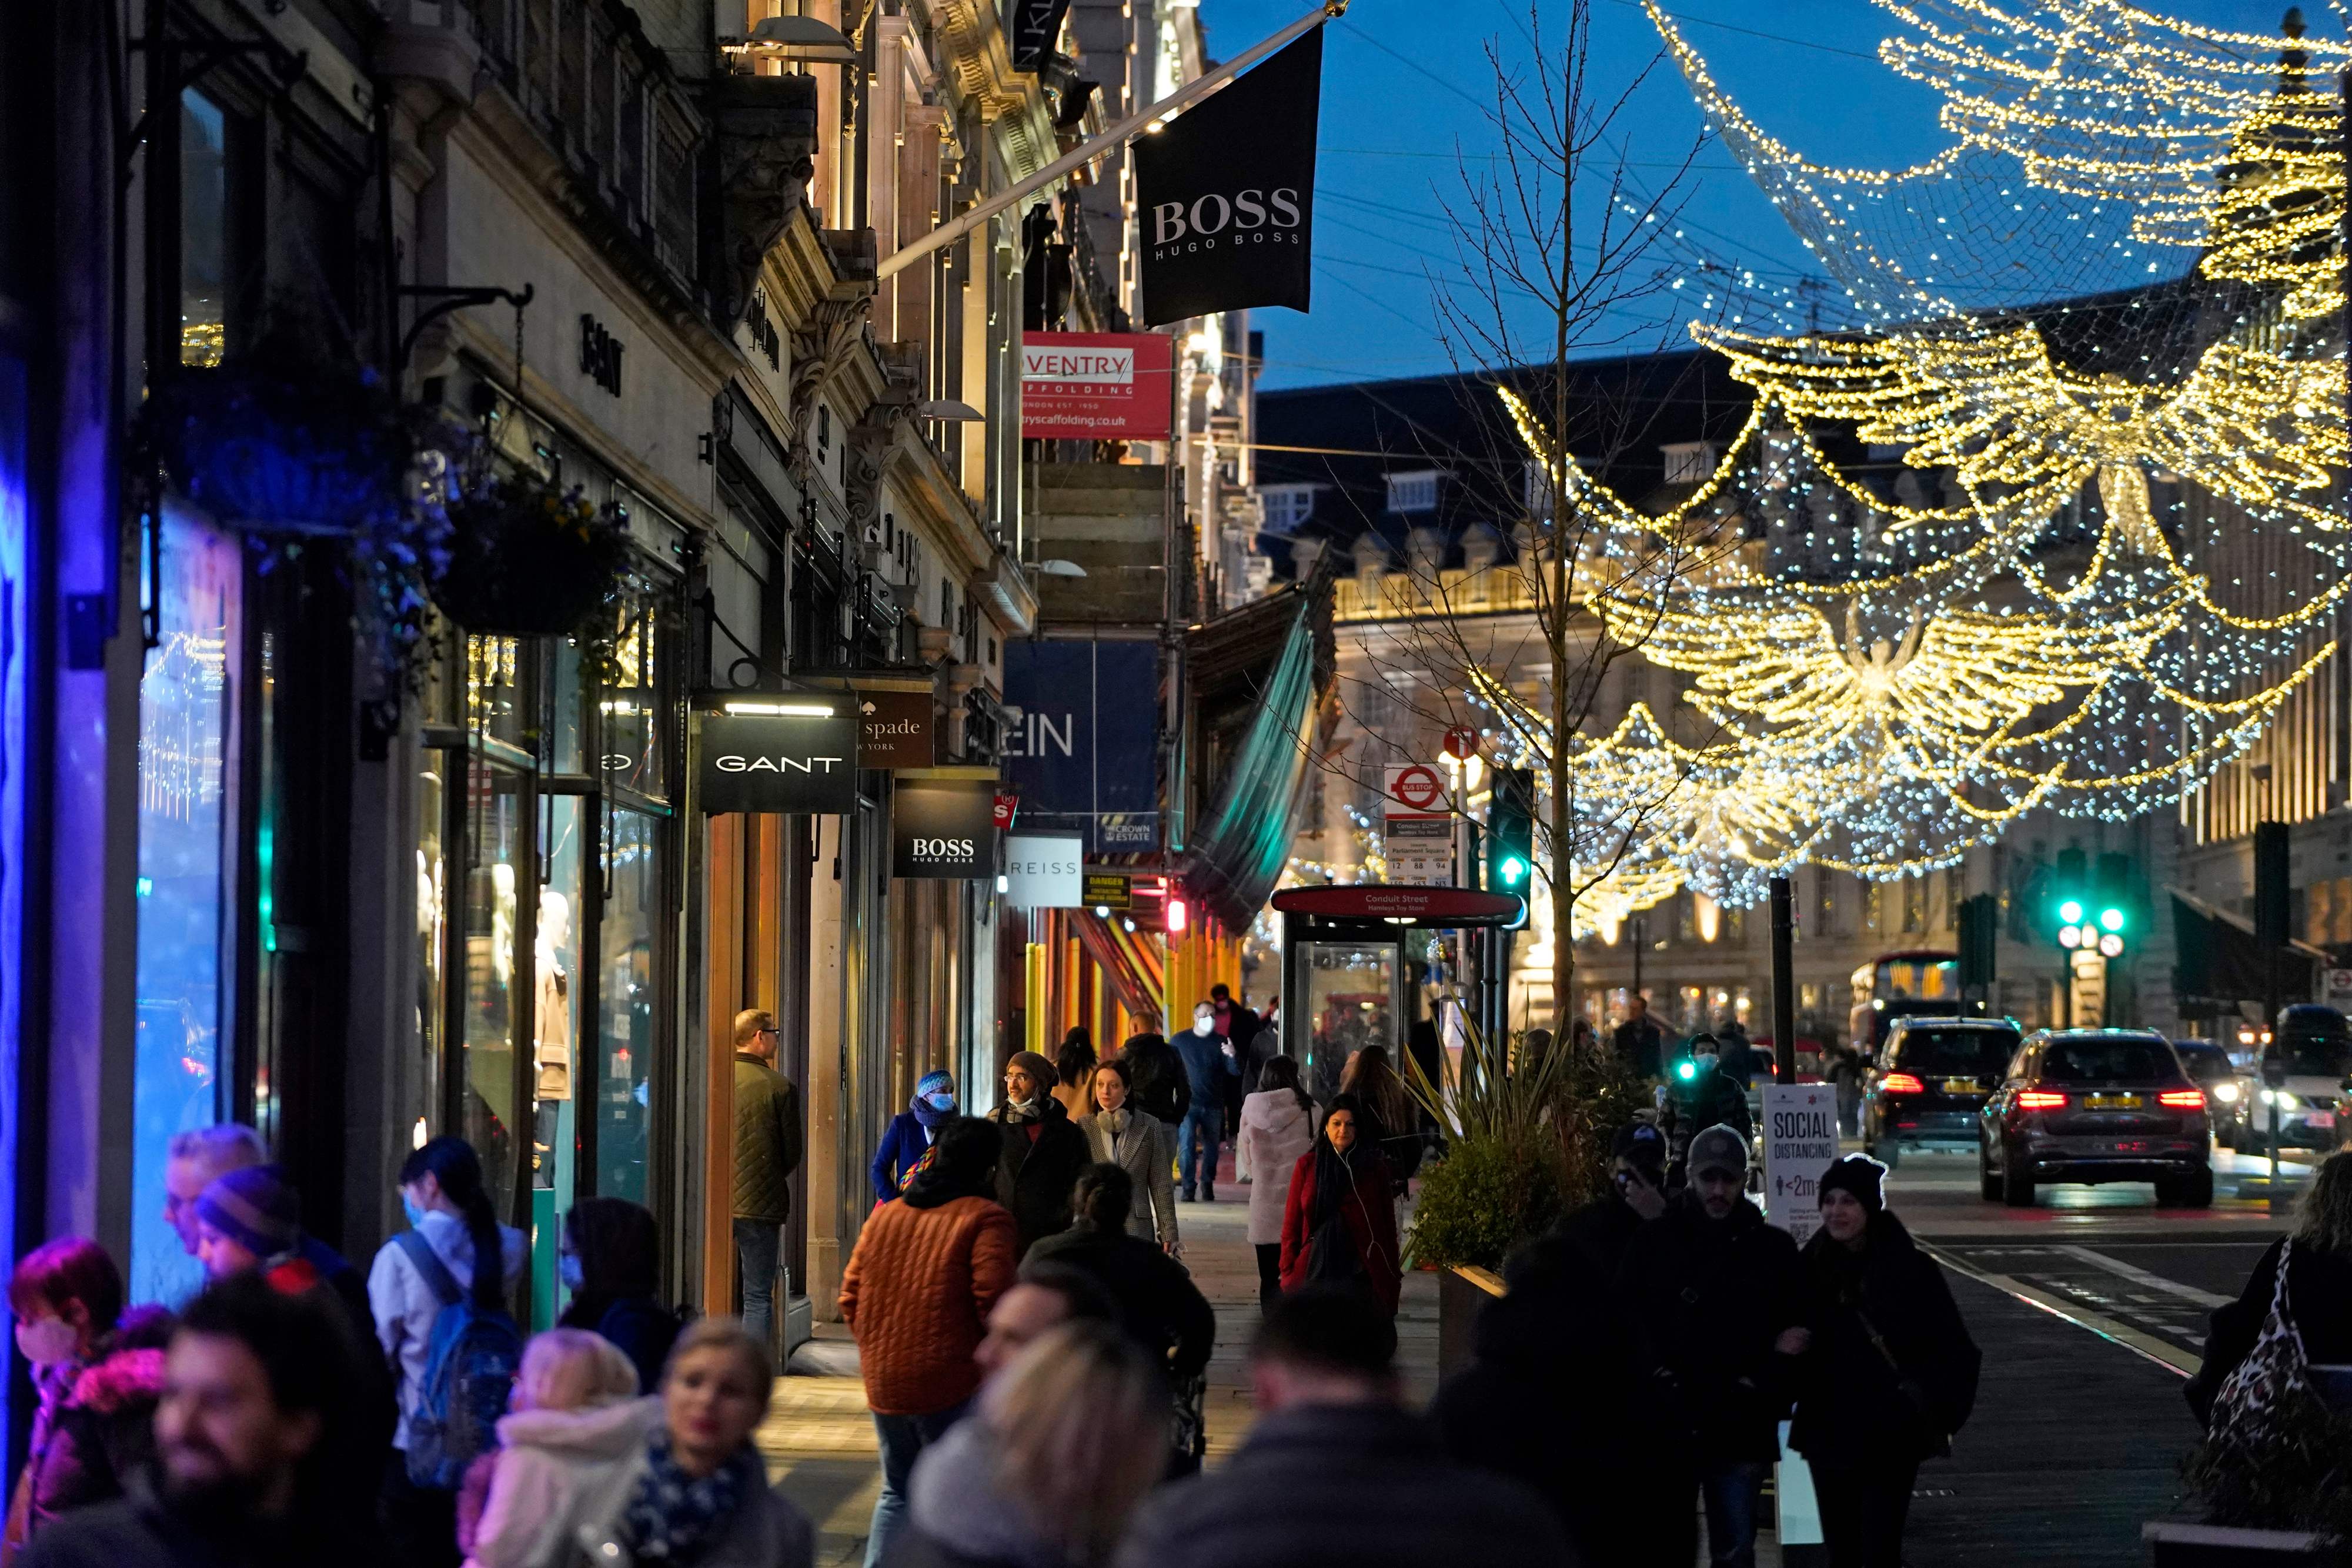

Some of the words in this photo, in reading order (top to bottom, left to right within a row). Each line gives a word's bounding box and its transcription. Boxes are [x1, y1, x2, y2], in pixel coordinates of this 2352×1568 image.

[1152, 188, 1300, 245] BOSS
[1155, 239, 1215, 260] HUGO
[1235, 232, 1298, 245] BOSS
[1023, 355, 1127, 375] VENTRY
[866, 718, 920, 739] spade
[716, 755, 843, 773] GANT
[994, 805, 1008, 818] S
[913, 838, 974, 857] BOSS
[1011, 862, 1076, 874] REISS
[1090, 877, 1124, 885] DANGER
[1774, 1112, 1830, 1138] SOCIAL
[1775, 1143, 1831, 1159] DISTANCING
[1795, 1175, 1815, 1196] 2m
